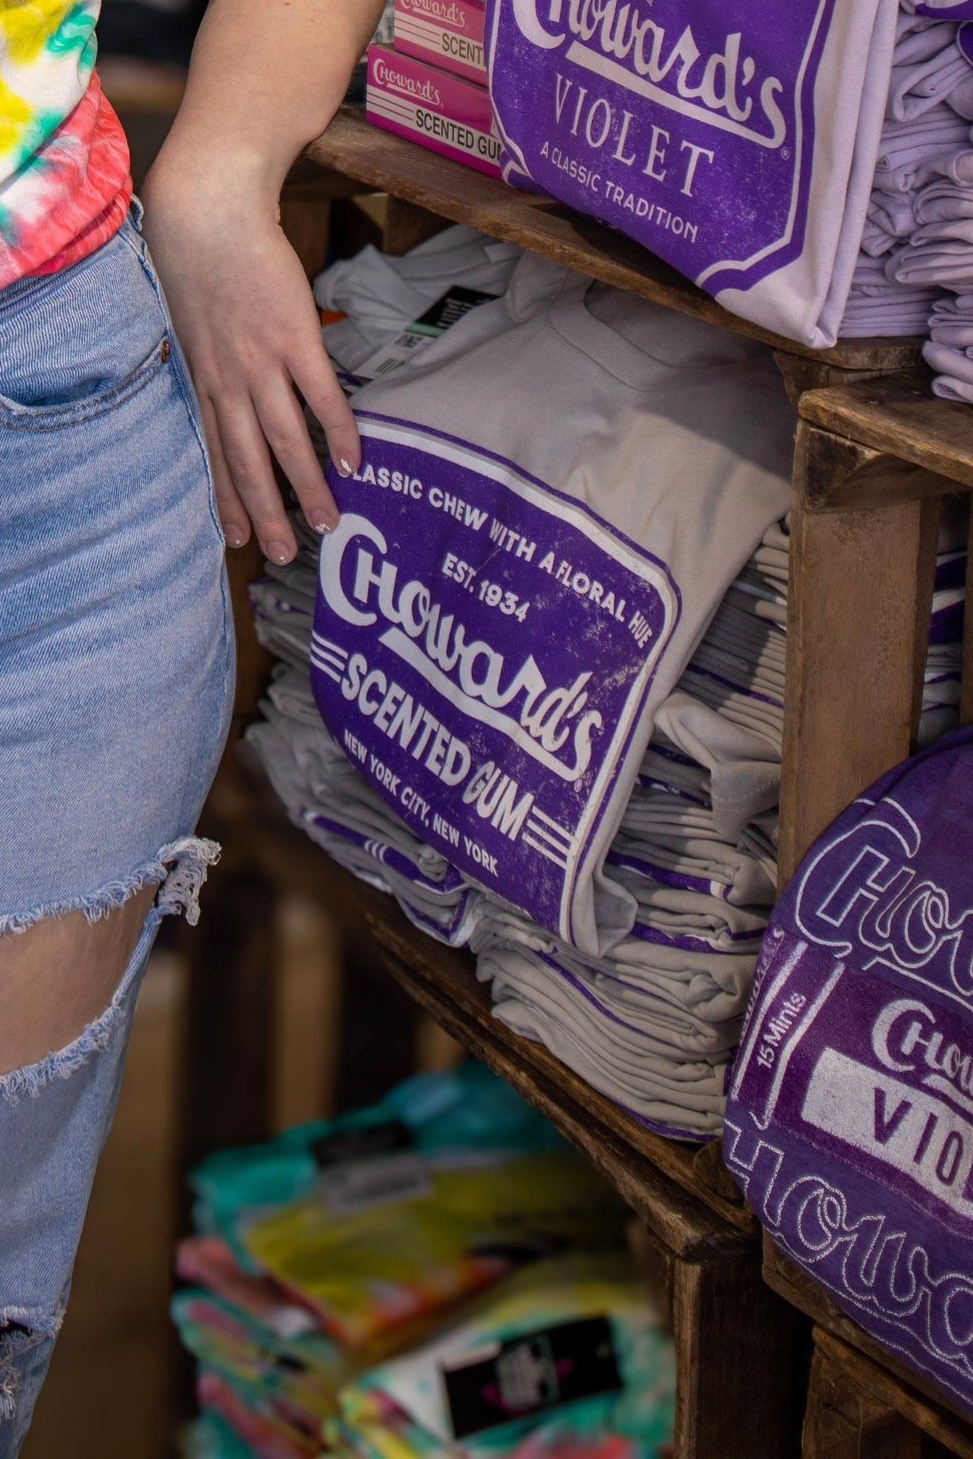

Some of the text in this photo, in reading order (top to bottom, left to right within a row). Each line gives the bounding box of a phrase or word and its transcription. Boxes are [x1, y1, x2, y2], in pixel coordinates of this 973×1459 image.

[442, 33, 487, 67] SCENT
[415, 109, 475, 150] SCENTED
[554, 74, 714, 197] VIOLET
[540, 141, 698, 243] A CLASSIC TRADITION
[338, 463, 654, 649] LASSIC CHEW WITH A FLORAL HUE
[442, 552, 531, 623] EST. 1934
[340, 653, 535, 841] SCENTED GUM
[344, 728, 499, 878] NEW YORK CITY, NEW YORK
[757, 1045, 776, 1069] 15
[763, 992, 807, 1042] Mints
